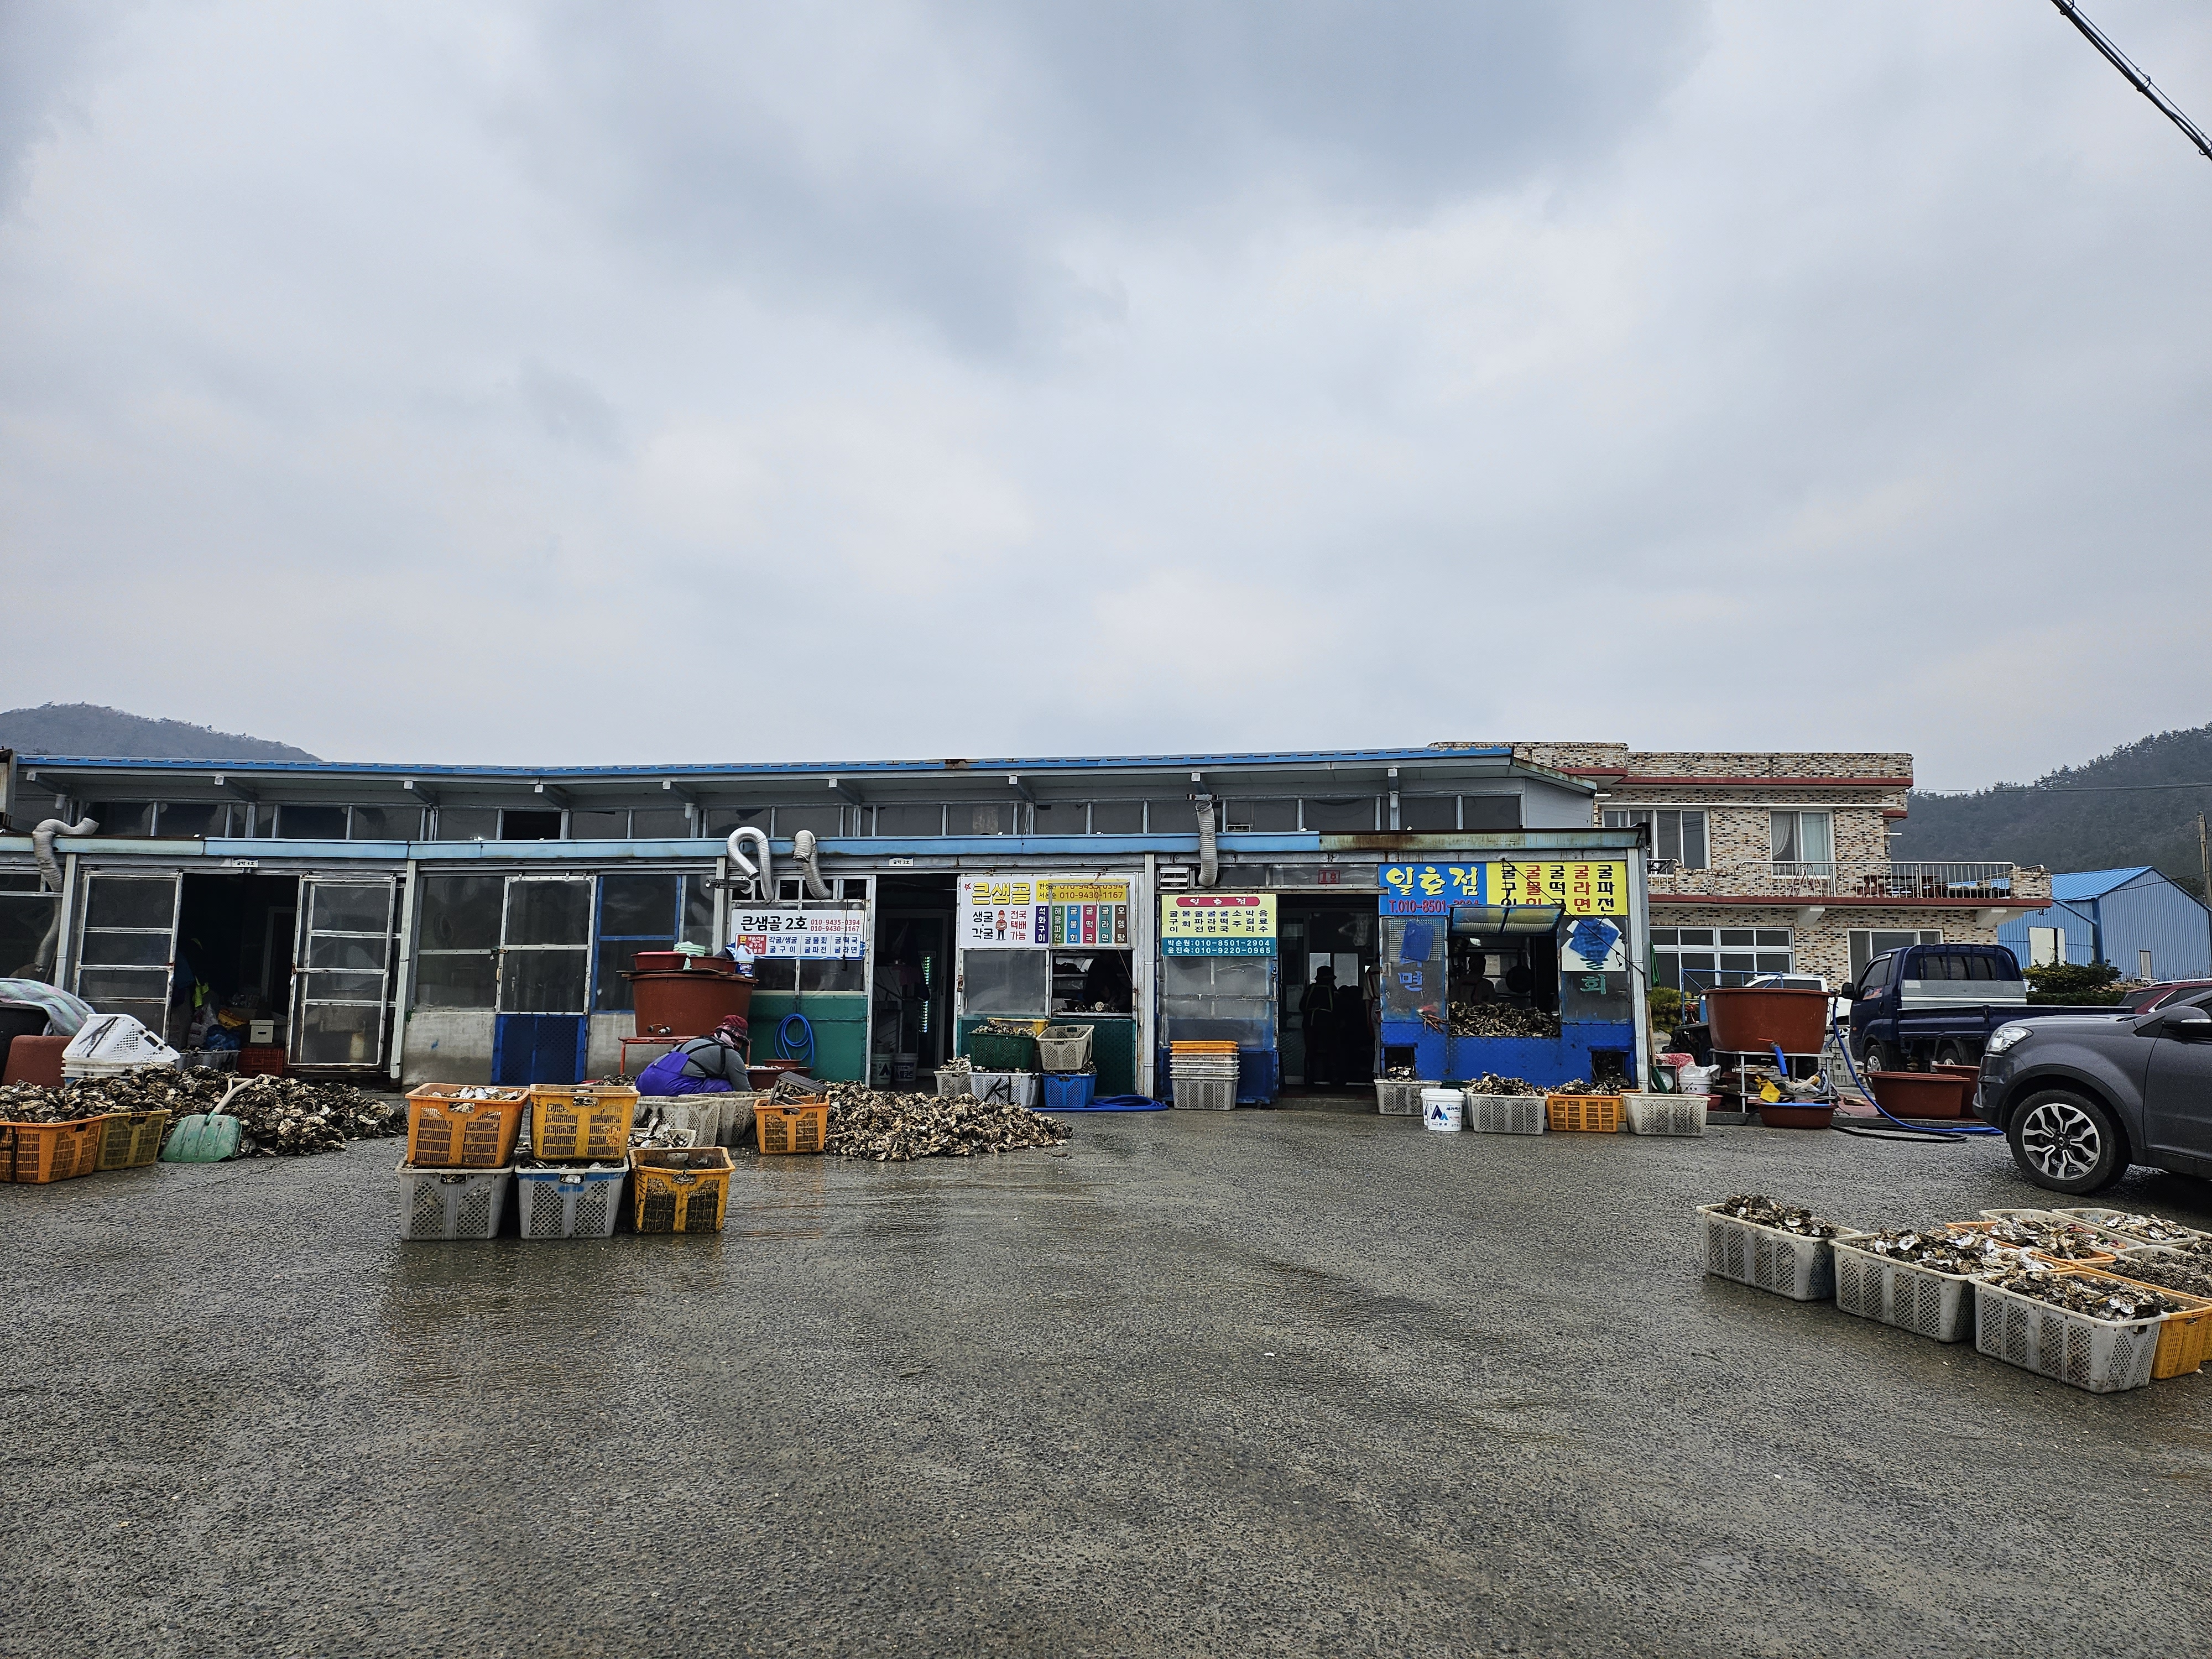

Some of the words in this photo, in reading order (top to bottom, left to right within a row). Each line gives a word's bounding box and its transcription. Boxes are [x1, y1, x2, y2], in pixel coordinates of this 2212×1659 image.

[1386, 866, 1479, 896] 일호점
[1573, 865, 1591, 912] 굴라면
[1597, 864, 1615, 912] 굴파전
[972, 883, 1031, 905] 큰샘골
[741, 916, 782, 931] 큰샘골
[785, 916, 807, 930] 2호
[973, 911, 994, 922] 생굴
[1011, 910, 1026, 919] 전국
[1011, 921, 1026, 930] 택배
[1053, 907, 1062, 942] 해물파전
[1169, 910, 1178, 932] 굴구이
[1194, 910, 1203, 932] 굴파전
[1207, 910, 1216, 932] 굴라면
[1219, 910, 1229, 932] 굴떡국
[1232, 910, 1241, 927] 소주
[1245, 910, 1254, 932] 막걸리
[1258, 910, 1268, 932] 음료수
[972, 928, 993, 939] 각굴
[1010, 931, 1026, 940] 가능
